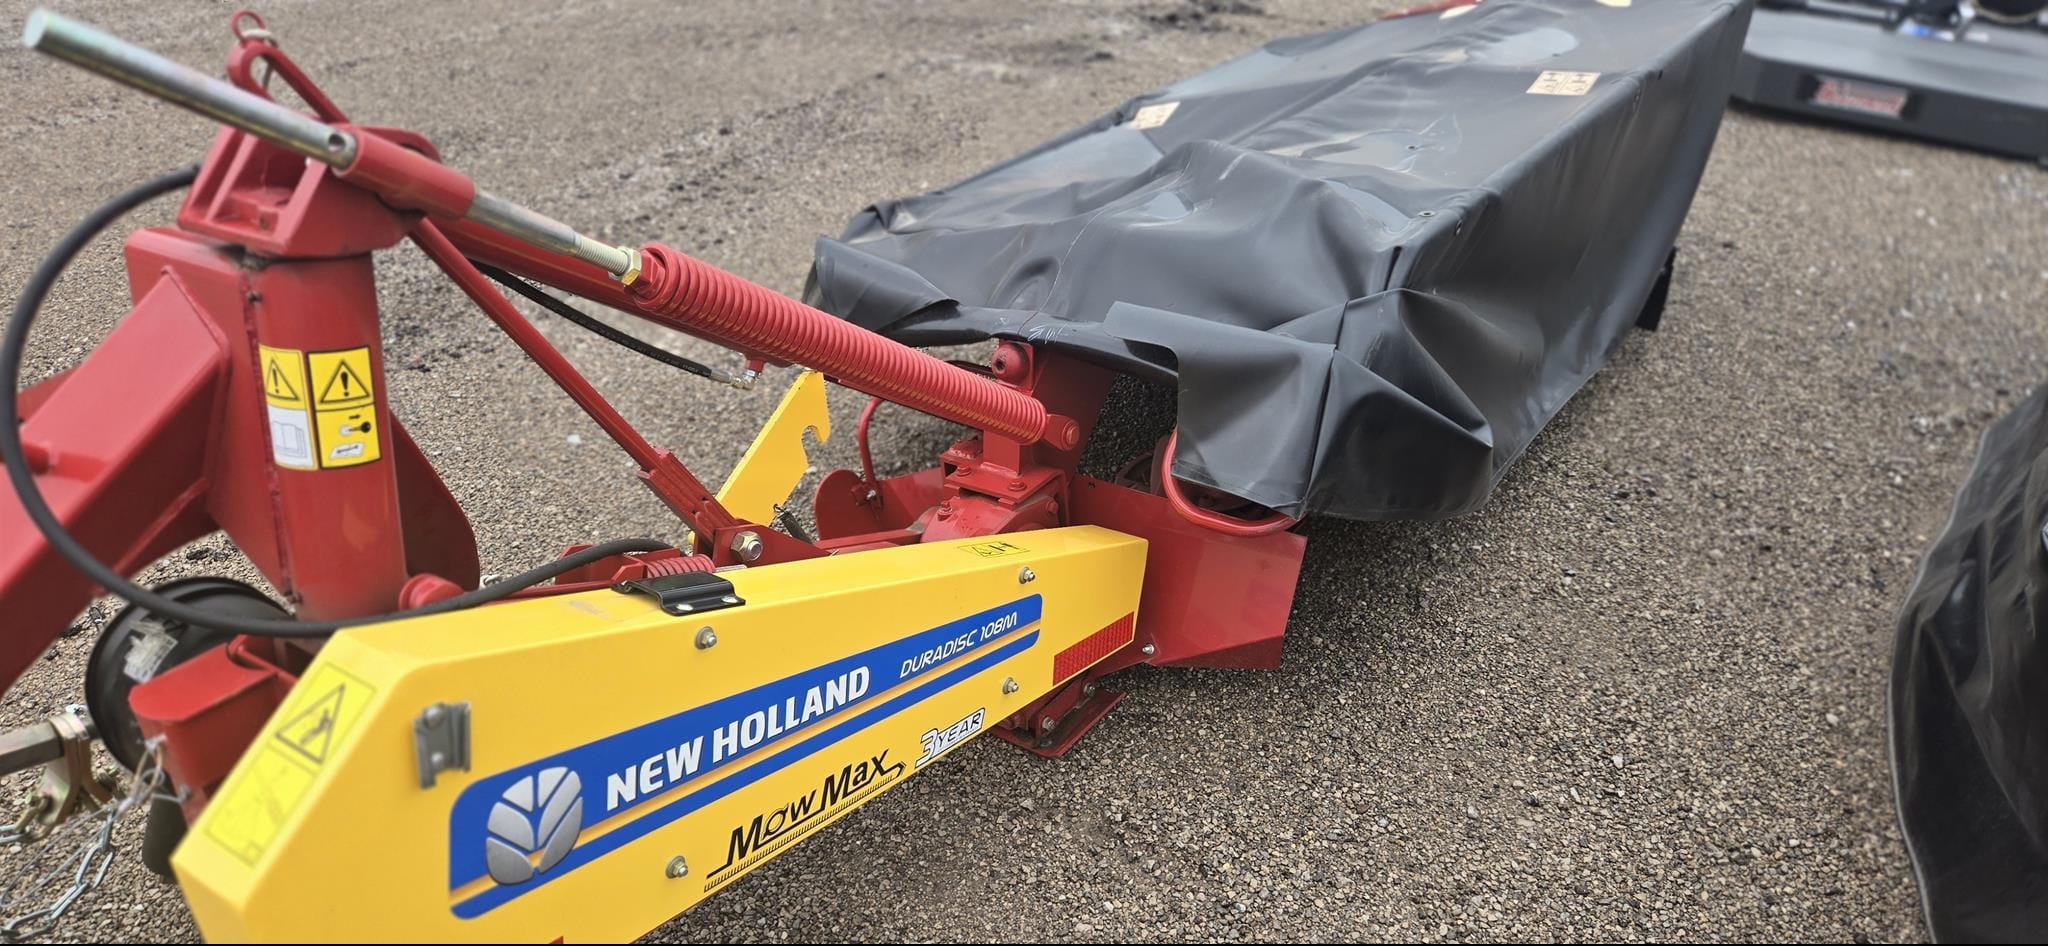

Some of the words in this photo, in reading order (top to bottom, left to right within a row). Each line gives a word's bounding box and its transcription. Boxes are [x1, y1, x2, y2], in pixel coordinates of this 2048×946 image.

[900, 629, 978, 678] DURADISC
[980, 611, 1018, 642] 108M
[607, 735, 704, 812] NEW
[712, 665, 870, 763] HOLLAND
[820, 749, 889, 812] Max
